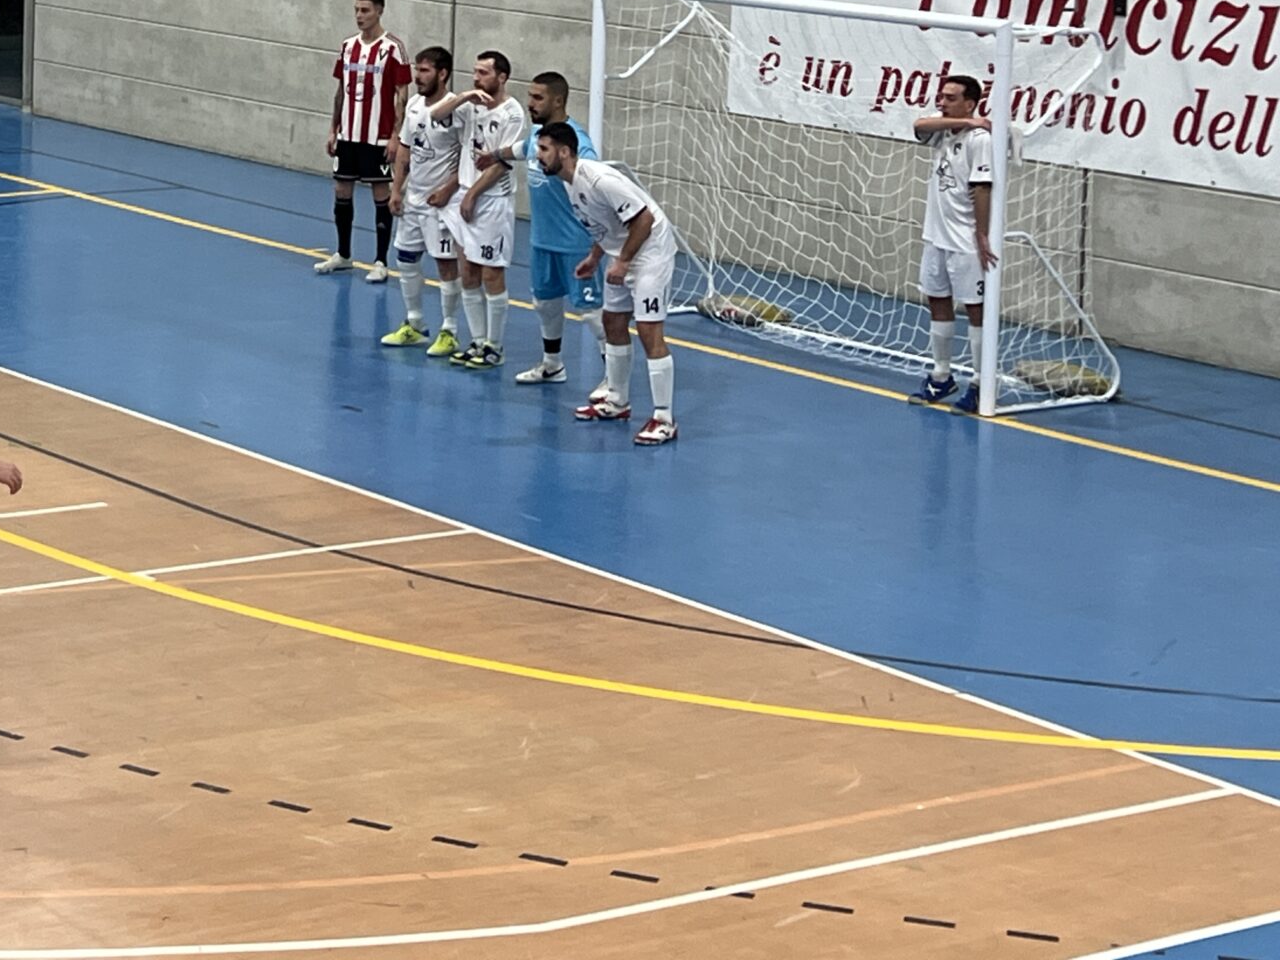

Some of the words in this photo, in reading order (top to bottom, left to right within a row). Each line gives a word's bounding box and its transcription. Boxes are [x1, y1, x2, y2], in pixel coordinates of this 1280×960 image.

[801, 56, 853, 97] un
[1172, 87, 1280, 158] dell
[480, 244, 494, 260] 18
[643, 297, 659, 314] 14
